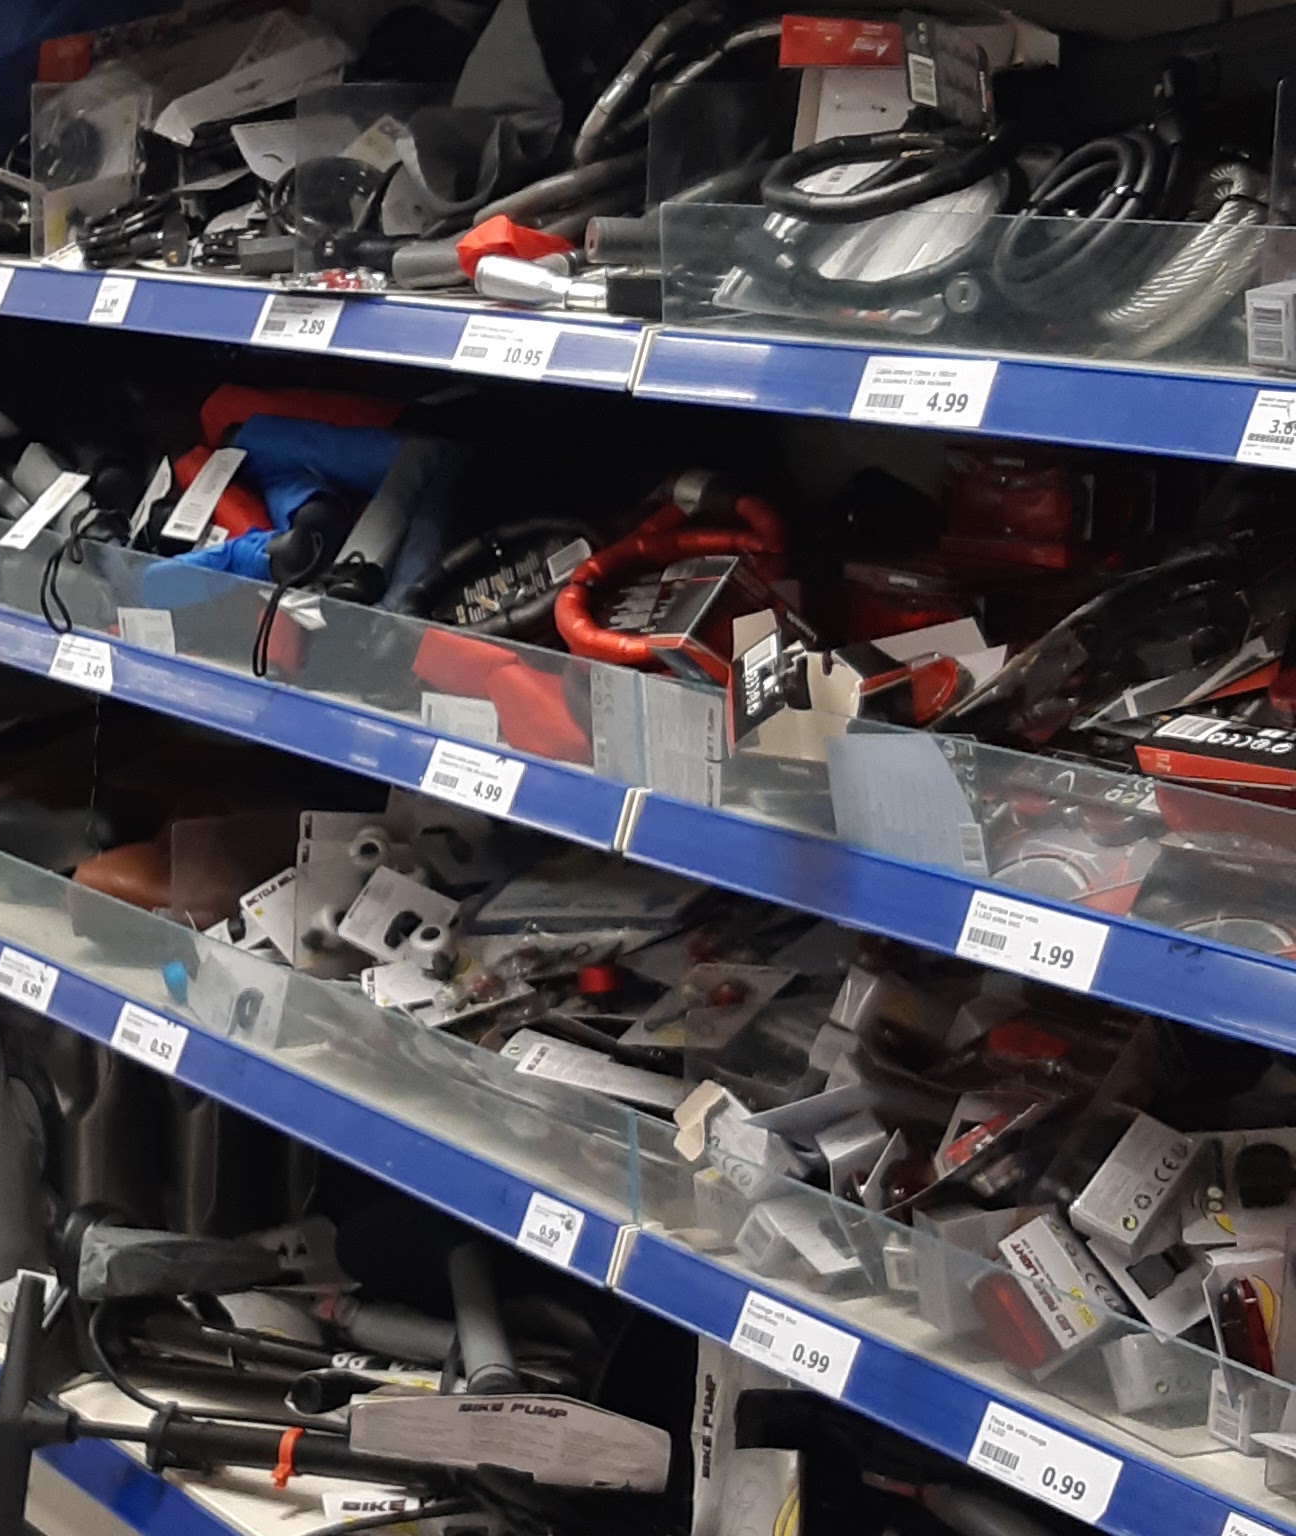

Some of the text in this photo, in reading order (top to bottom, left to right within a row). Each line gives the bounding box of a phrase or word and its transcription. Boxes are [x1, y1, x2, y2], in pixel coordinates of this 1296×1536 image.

[502, 346, 544, 367] 10.95
[926, 391, 969, 413] 4.99
[472, 780, 503, 802] 4.99
[1029, 940, 1075, 970] 1.99
[539, 1224, 561, 1243] 0.99
[792, 1343, 830, 1374] 0.99
[458, 1402, 569, 1419] BIKE PUMP
[1041, 1465, 1087, 1501] 0.99
[341, 1498, 407, 1513] BIKE
